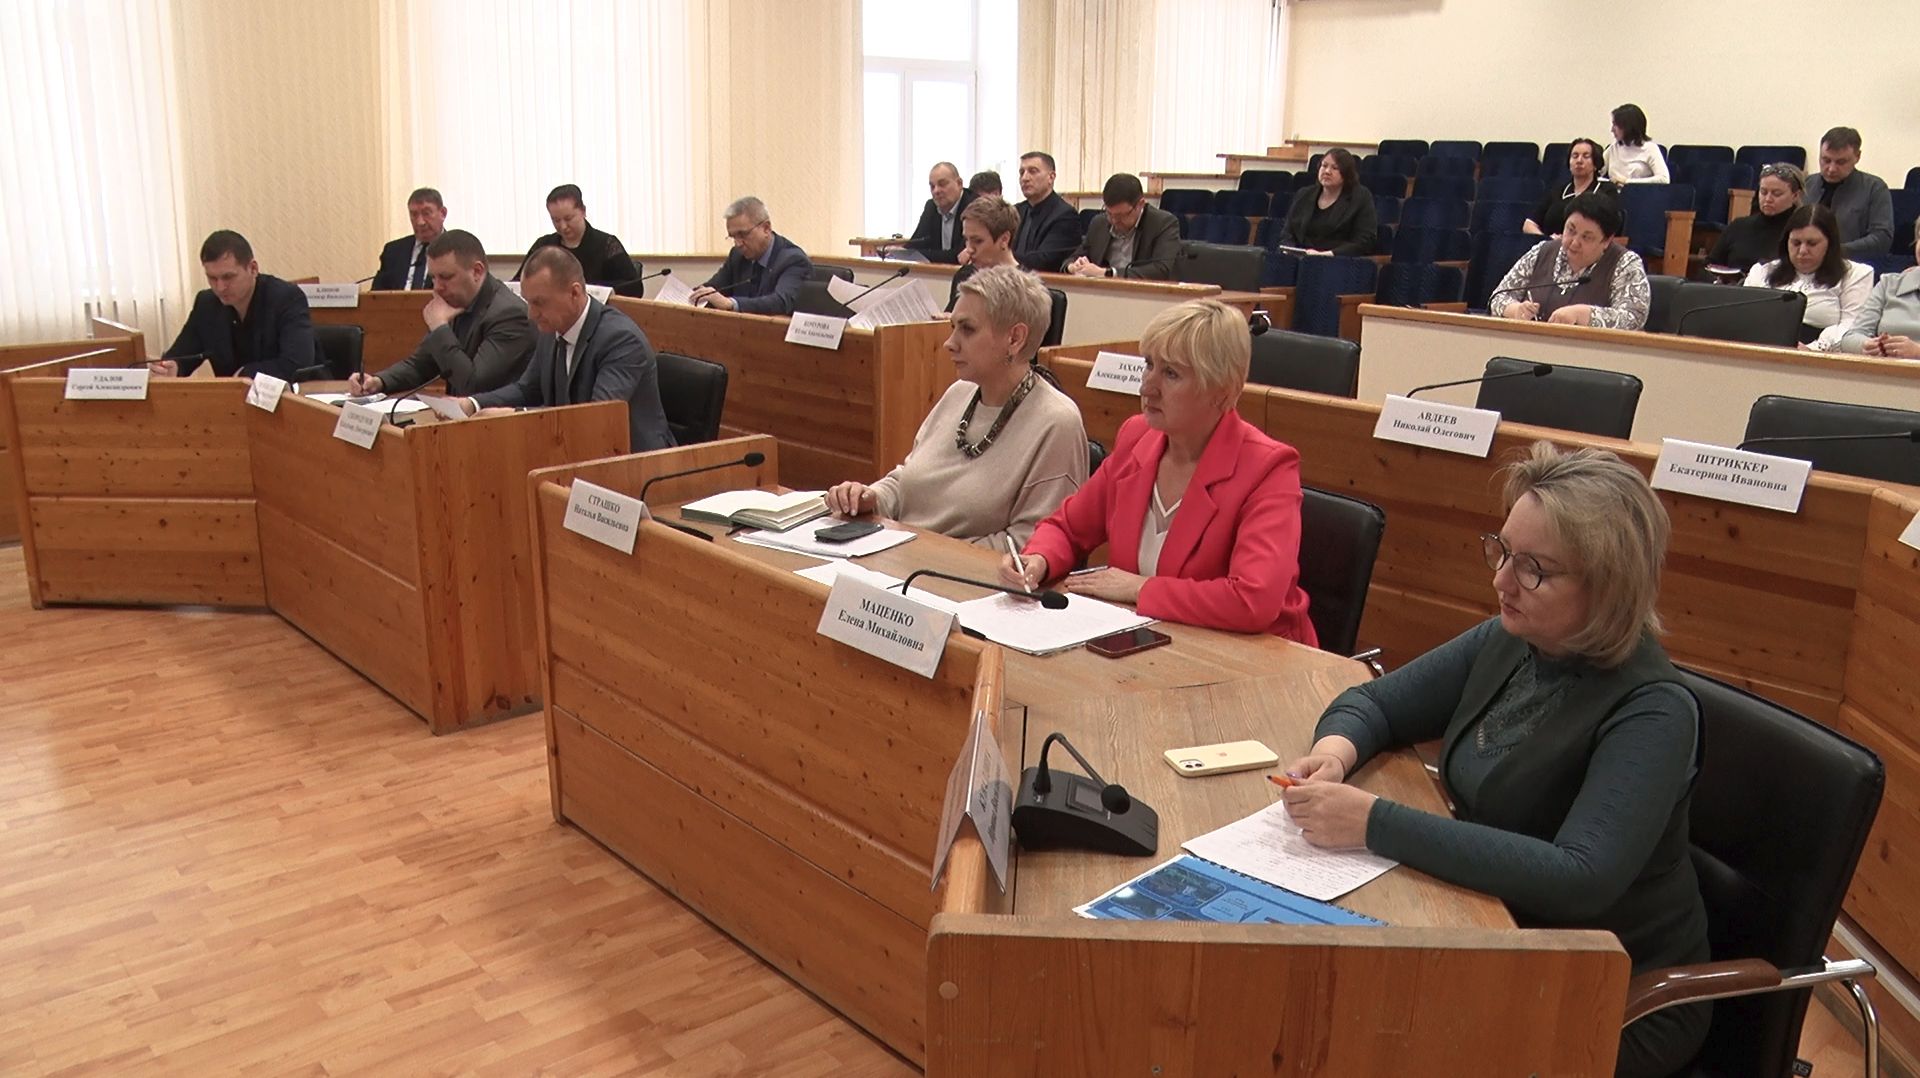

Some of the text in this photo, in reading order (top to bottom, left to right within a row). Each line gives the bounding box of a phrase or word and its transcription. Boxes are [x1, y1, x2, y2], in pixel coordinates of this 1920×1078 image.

[1095, 370, 1128, 383] Александр
[1417, 411, 1458, 425] АВДЕЕВ
[1393, 419, 1476, 441] Николай Олегович
[1695, 453, 1769, 474] ШТРИККЕР
[1669, 463, 1787, 492] Екатерина Ивановна
[588, 494, 621, 514] СТРАШКО
[573, 503, 629, 532] Наталья Васильевна
[859, 598, 915, 628] МАЦЕНКО
[838, 609, 925, 652] Елена Михайловна
